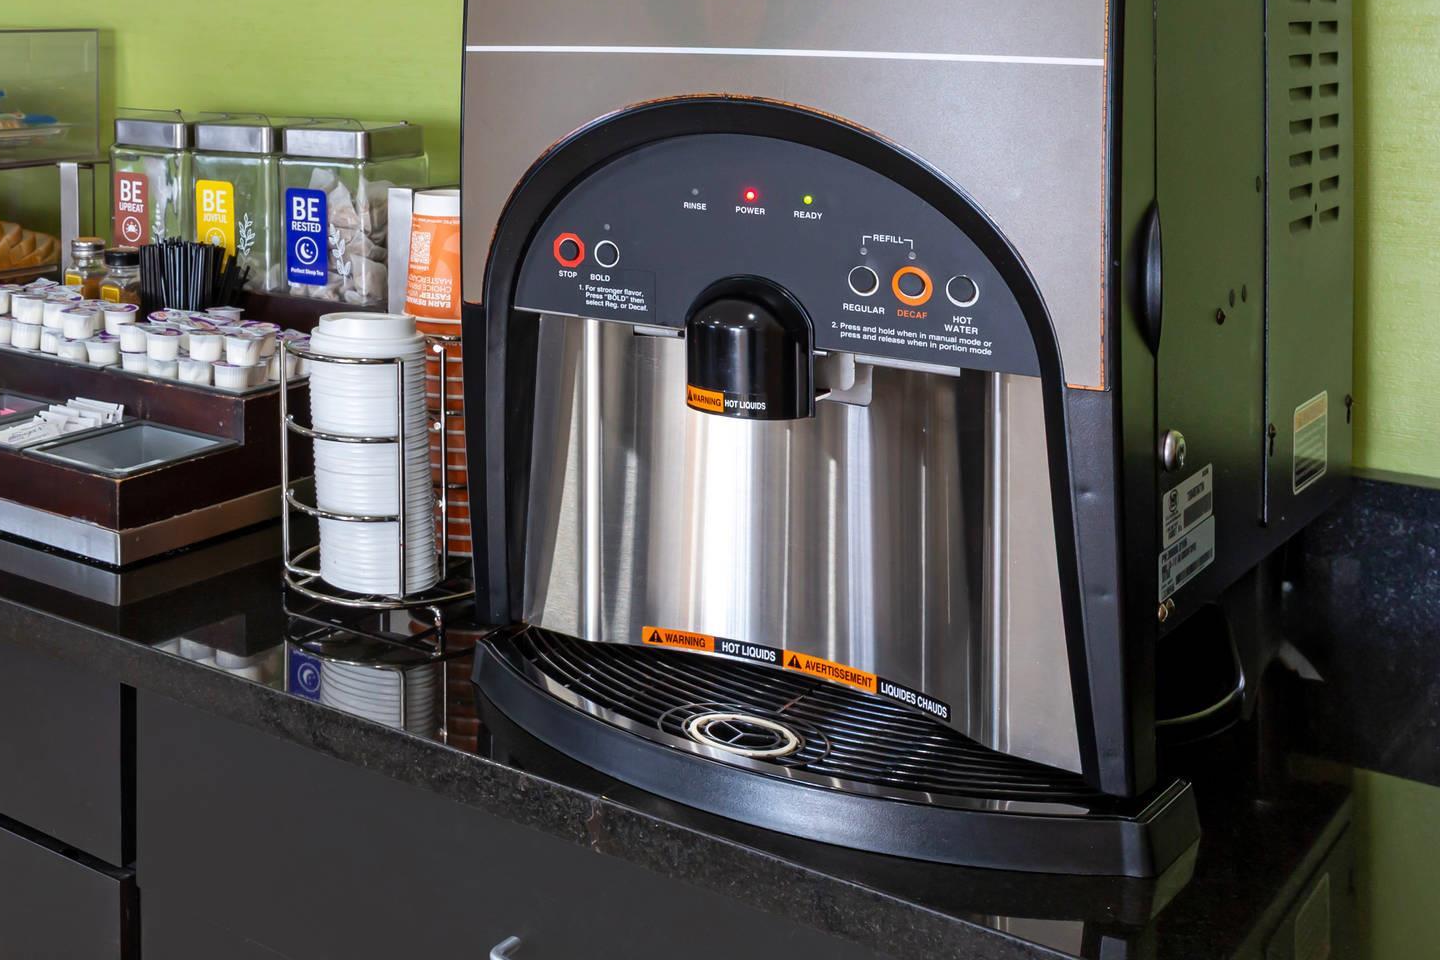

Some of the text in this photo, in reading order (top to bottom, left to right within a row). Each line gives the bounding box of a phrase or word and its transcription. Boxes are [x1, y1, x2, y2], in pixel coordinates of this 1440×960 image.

[120, 179, 143, 203] BE
[203, 189, 227, 213] BE
[683, 201, 707, 211] RINSE
[119, 201, 144, 213] UPBEAT
[292, 196, 320, 222] BE
[735, 206, 766, 215] POWER
[203, 212, 228, 224] JOYFUL
[793, 210, 823, 220] READY
[291, 220, 322, 233] RESTED
[873, 234, 904, 244] REFILL
[558, 270, 578, 279] STOP
[590, 273, 610, 282] BOLD
[585, 291, 603, 299] Press
[597, 286, 623, 295] stronger
[842, 302, 885, 315] REGULAR
[897, 309, 928, 319] DECAF
[952, 316, 972, 325] HOT
[840, 322, 861, 331] Press
[878, 327, 895, 335] hold
[896, 330, 918, 338] when
[919, 331, 927, 339] in
[928, 334, 957, 343] manual
[959, 338, 982, 346] mode
[944, 323, 978, 335] WATER
[840, 331, 993, 356] press and release when in portion mode
[724, 399, 738, 408] HOT
[739, 401, 766, 410] LIQUIDS
[664, 632, 948, 719] WARNING HOT LIQUIDS AVERTISSEMENT LIQUIDES CHAUDS
